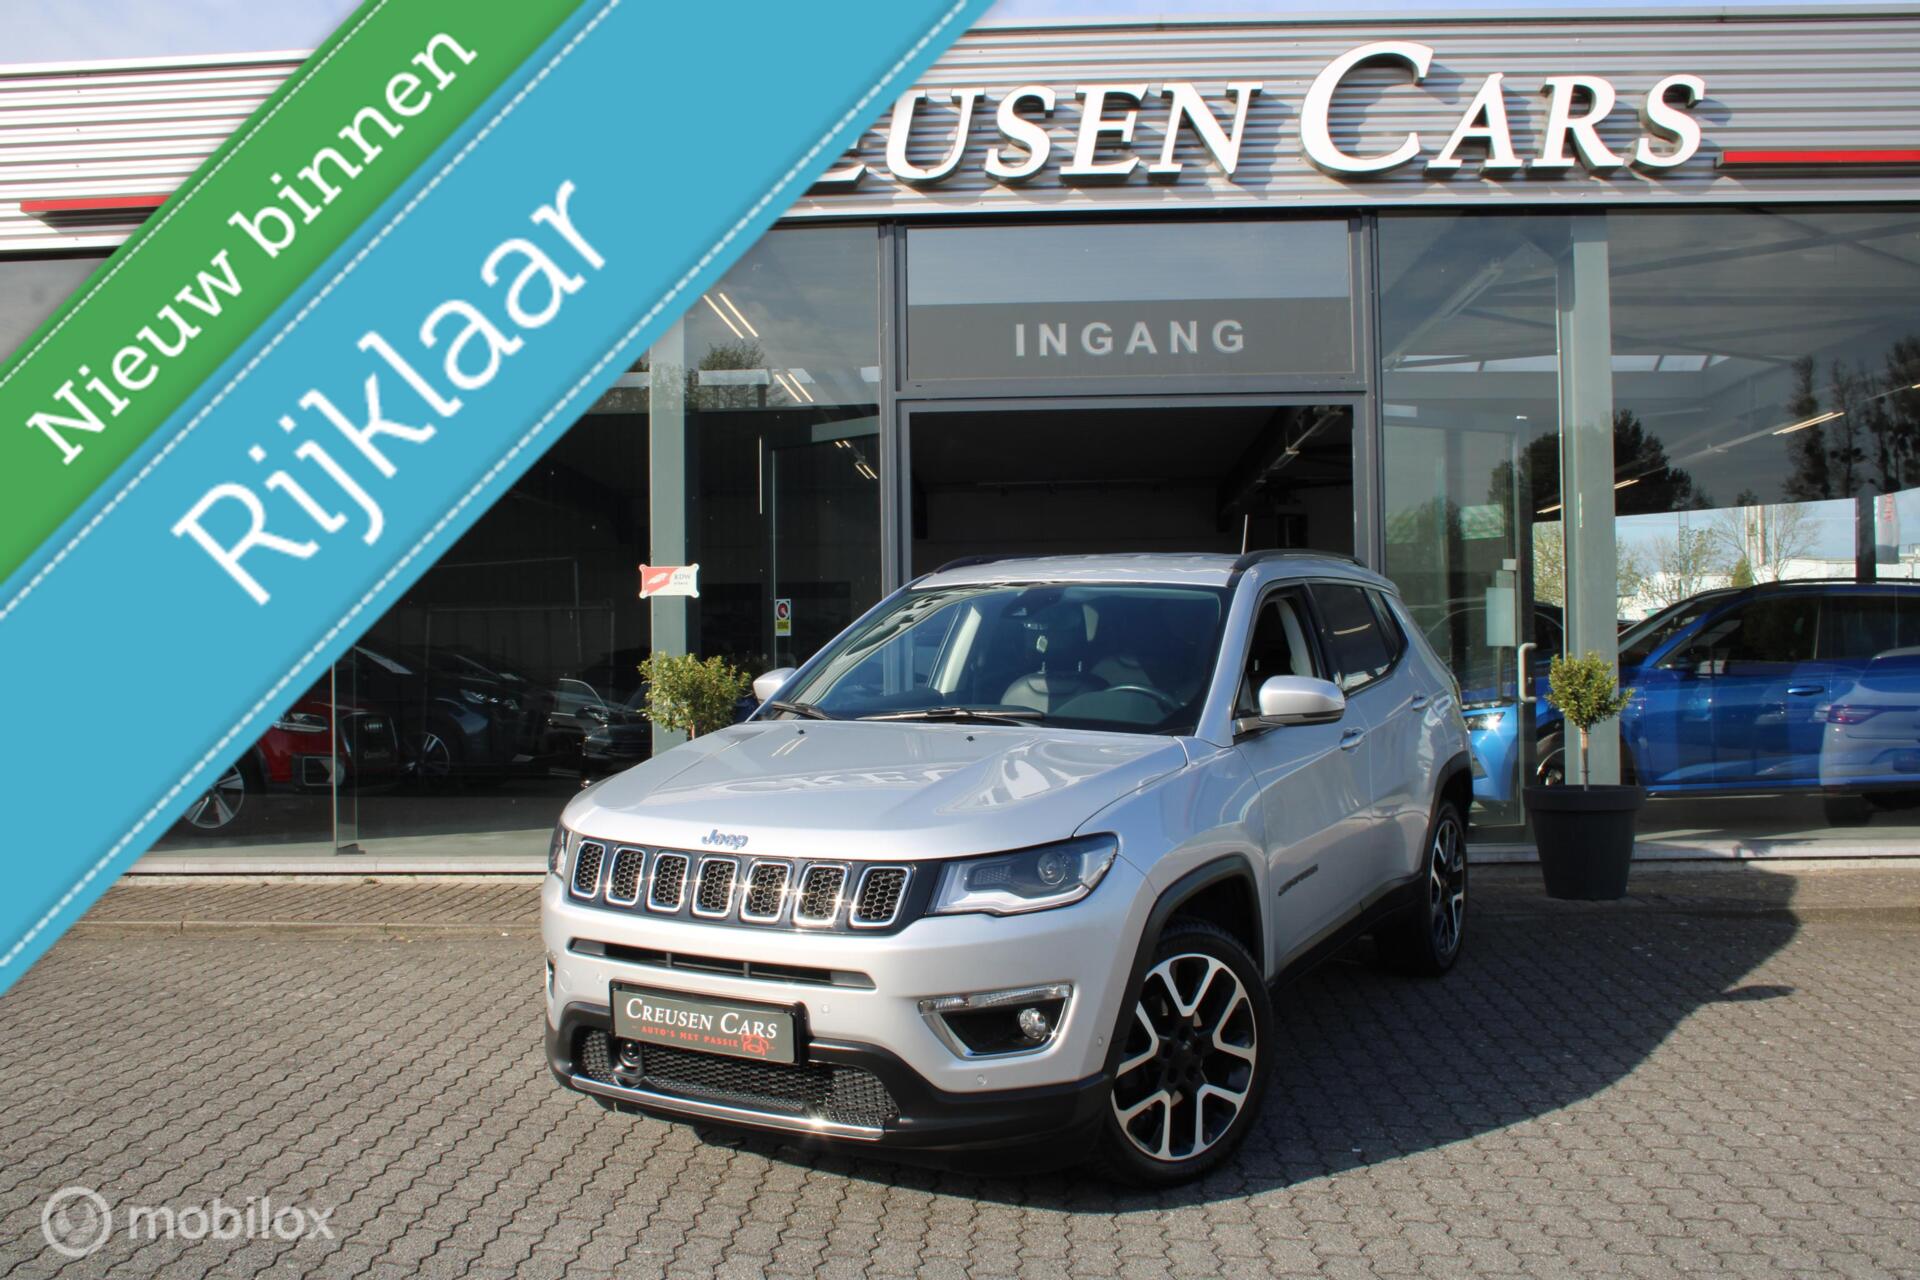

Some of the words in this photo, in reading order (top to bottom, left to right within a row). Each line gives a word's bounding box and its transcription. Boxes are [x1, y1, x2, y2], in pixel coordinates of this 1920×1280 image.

[1300, 40, 1706, 174] CARS
[1015, 319, 1245, 357] INGANG
[701, 828, 749, 850] Jeep
[626, 997, 714, 1031] CREUSEN
[720, 1012, 778, 1039] CARS
